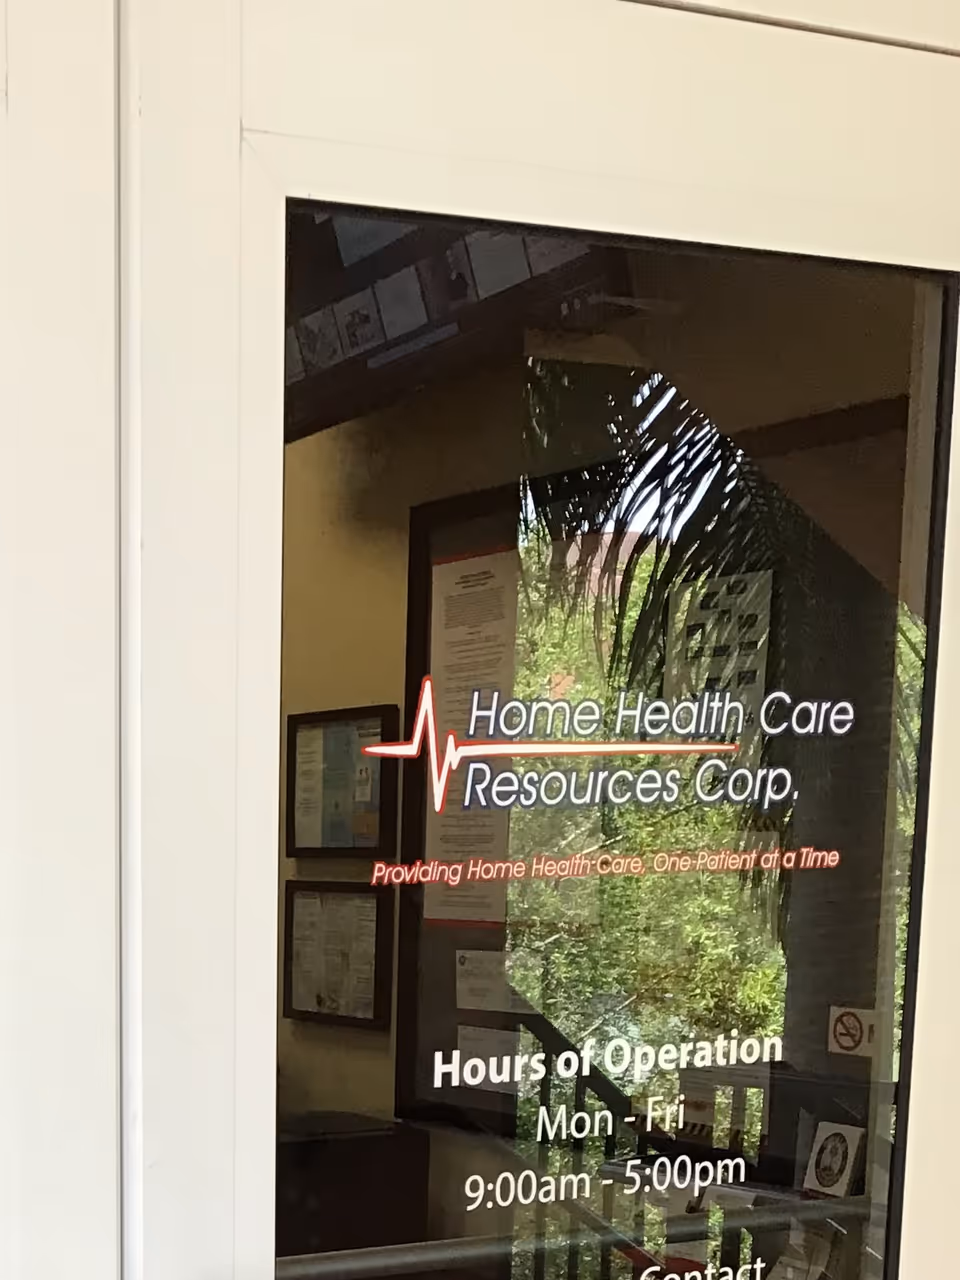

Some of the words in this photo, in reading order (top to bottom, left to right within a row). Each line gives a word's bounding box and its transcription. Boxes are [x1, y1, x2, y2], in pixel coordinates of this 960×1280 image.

[467, 689, 602, 737] Home
[614, 689, 745, 737] Health
[758, 690, 855, 736] Care
[462, 761, 681, 808] Resources
[695, 757, 799, 810] Corp.
[371, 860, 464, 886] Providing
[467, 858, 527, 881] Home
[530, 855, 592, 878] Health
[596, 853, 646, 875] Care,
[652, 852, 692, 873] One
[695, 850, 758, 871] Patient
[760, 848, 781, 869] at
[782, 850, 795, 869] a
[799, 847, 841, 869] Time
[433, 1049, 547, 1089] Hours
[556, 1037, 597, 1079] of
[603, 1028, 783, 1084] Operation
[536, 1103, 614, 1142] Mon
[623, 1115, 637, 1123] -
[645, 1094, 686, 1133] Fri
[464, 1169, 591, 1212] 9:00am
[601, 1178, 614, 1186] -
[623, 1154, 747, 1198] 5:00pm
